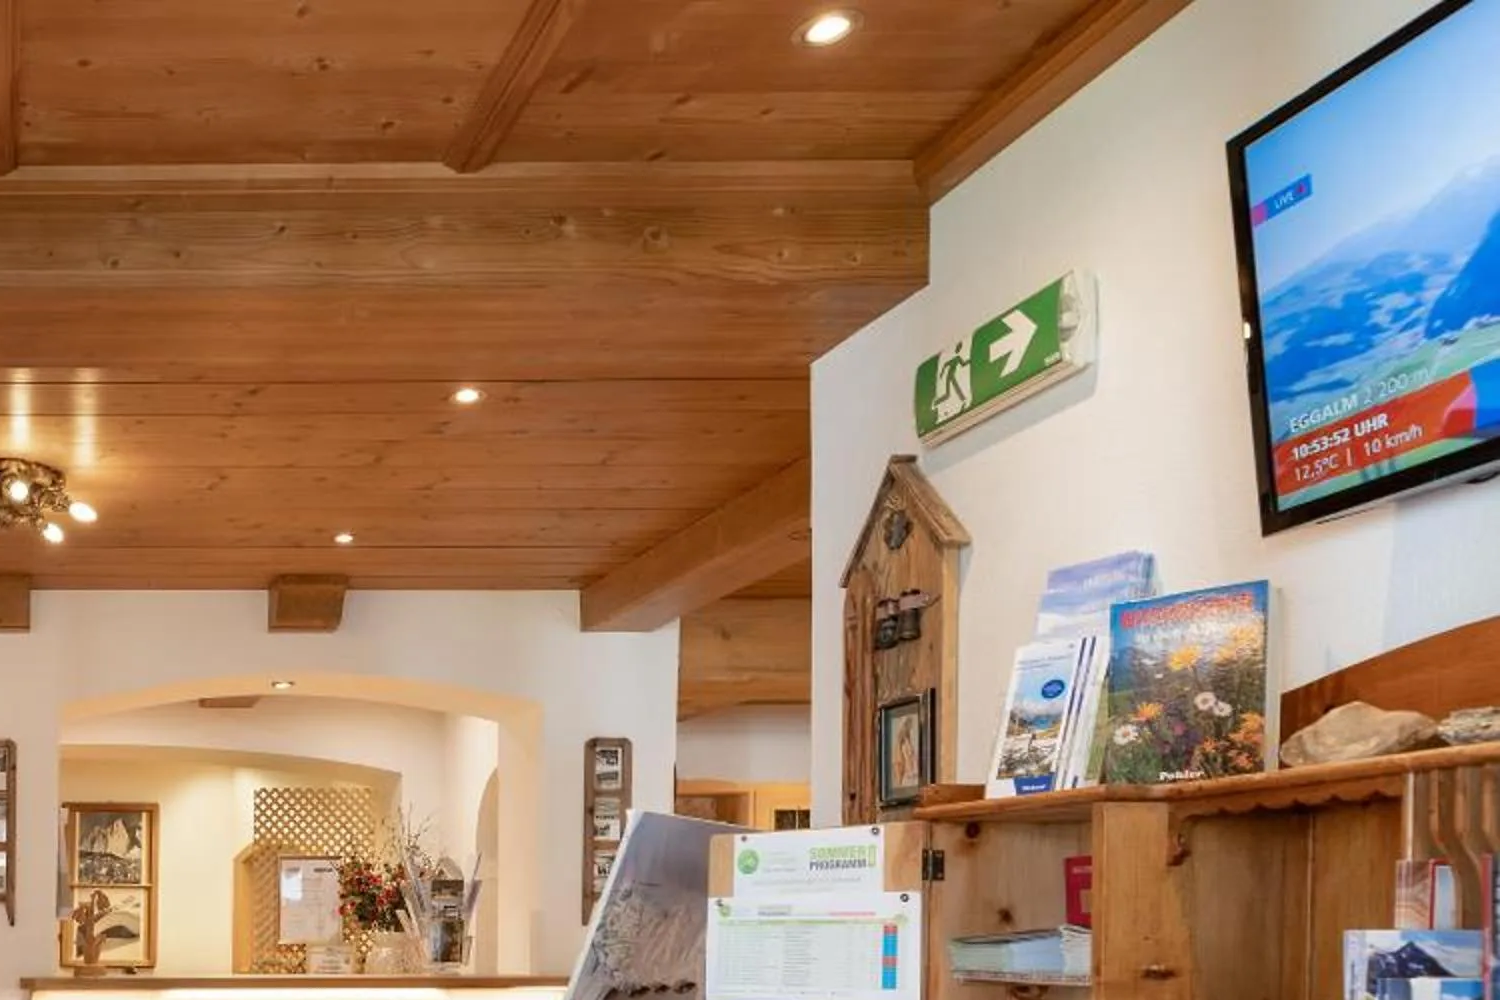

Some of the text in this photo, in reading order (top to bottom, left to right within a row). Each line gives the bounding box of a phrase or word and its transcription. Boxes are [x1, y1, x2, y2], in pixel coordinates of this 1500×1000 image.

[1289, 393, 1358, 433] EGGALM
[1380, 373, 1408, 397] 200
[1292, 412, 1389, 461] 10:53:52 UHR
[1363, 438, 1382, 458] 10
[1384, 423, 1424, 448] km/h
